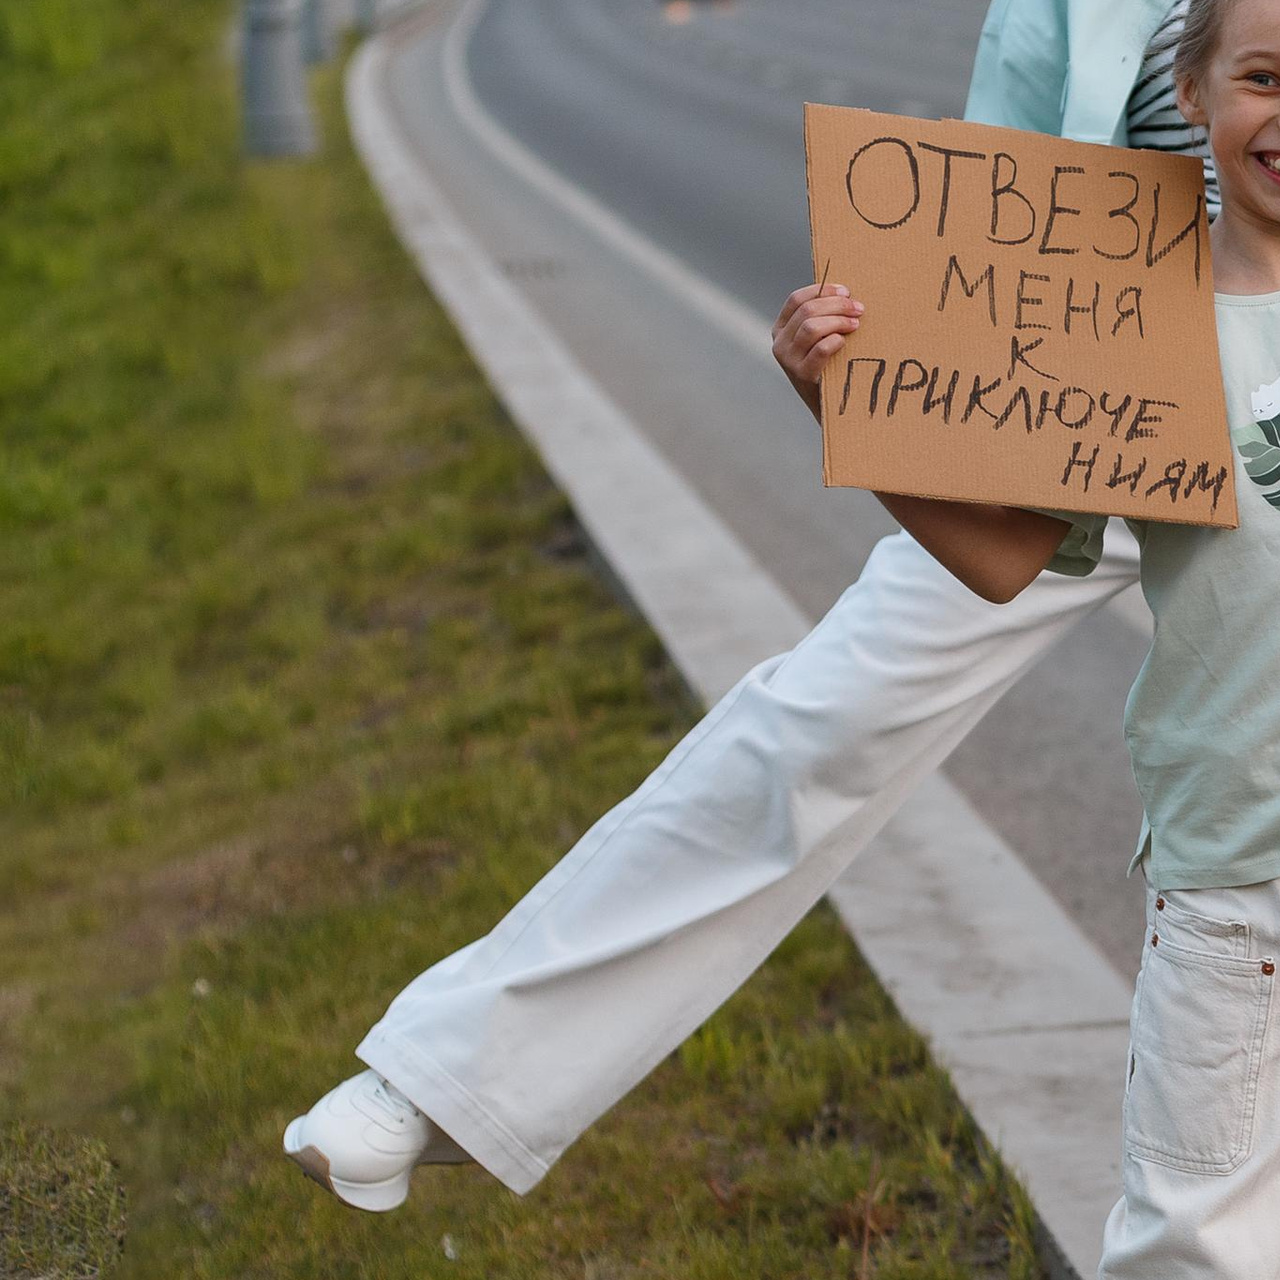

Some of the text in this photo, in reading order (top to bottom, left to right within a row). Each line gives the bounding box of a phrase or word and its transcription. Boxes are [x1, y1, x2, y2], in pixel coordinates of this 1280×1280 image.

[846, 137, 1204, 288] ОТВЕЗИ
[937, 255, 1144, 341] МЕНЯ
[838, 358, 1180, 442] ПРИКЛЮЧЕ
[1007, 335, 1060, 382] К
[1061, 440, 1228, 511] НИЯМ
